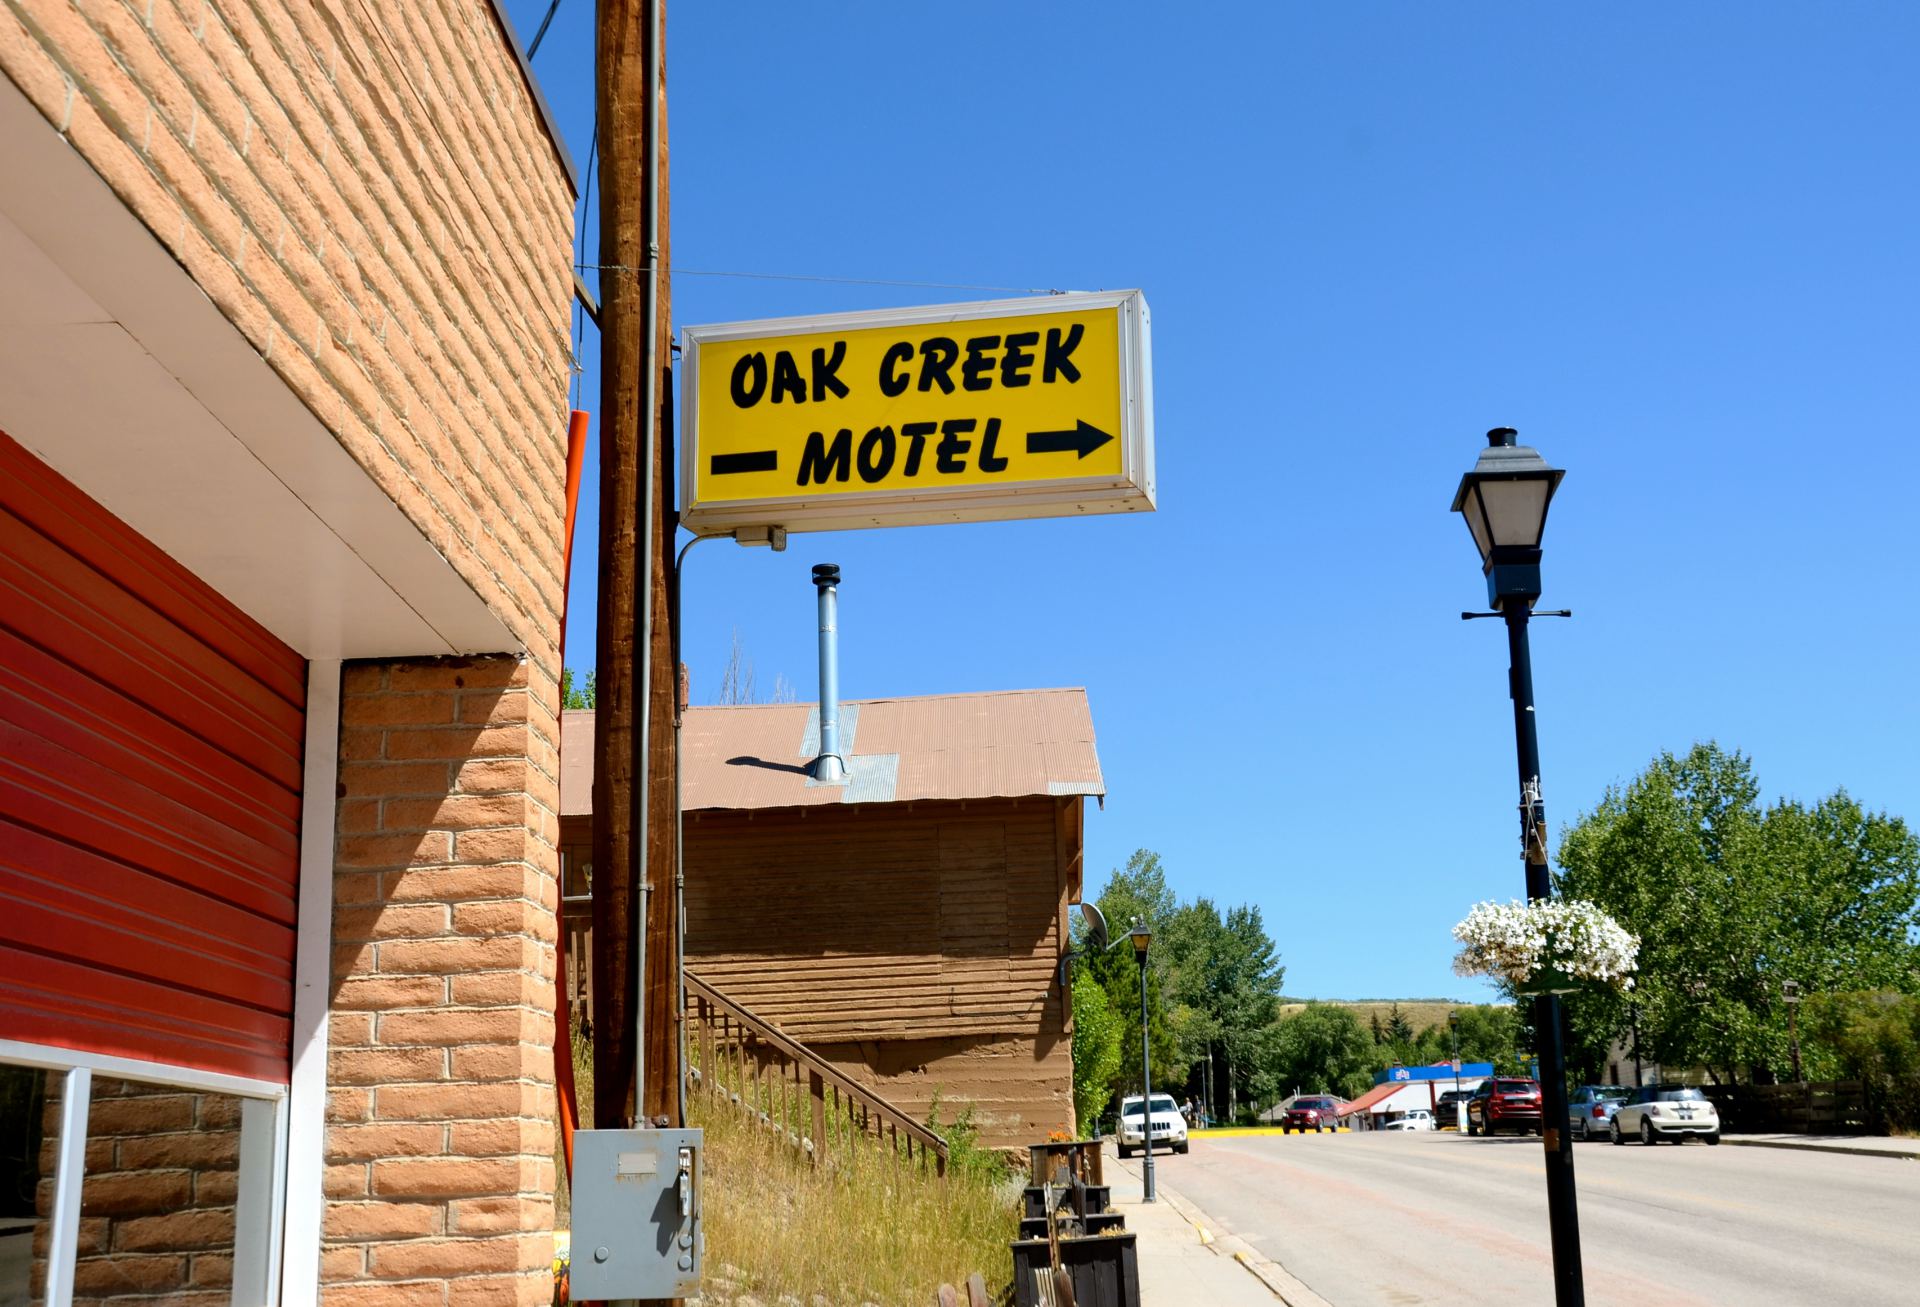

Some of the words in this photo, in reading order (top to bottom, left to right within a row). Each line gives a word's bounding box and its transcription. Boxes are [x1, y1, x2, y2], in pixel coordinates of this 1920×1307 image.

[731, 341, 850, 409] OAK
[879, 324, 1085, 398] CREEK
[797, 417, 1008, 487] MOTEL
